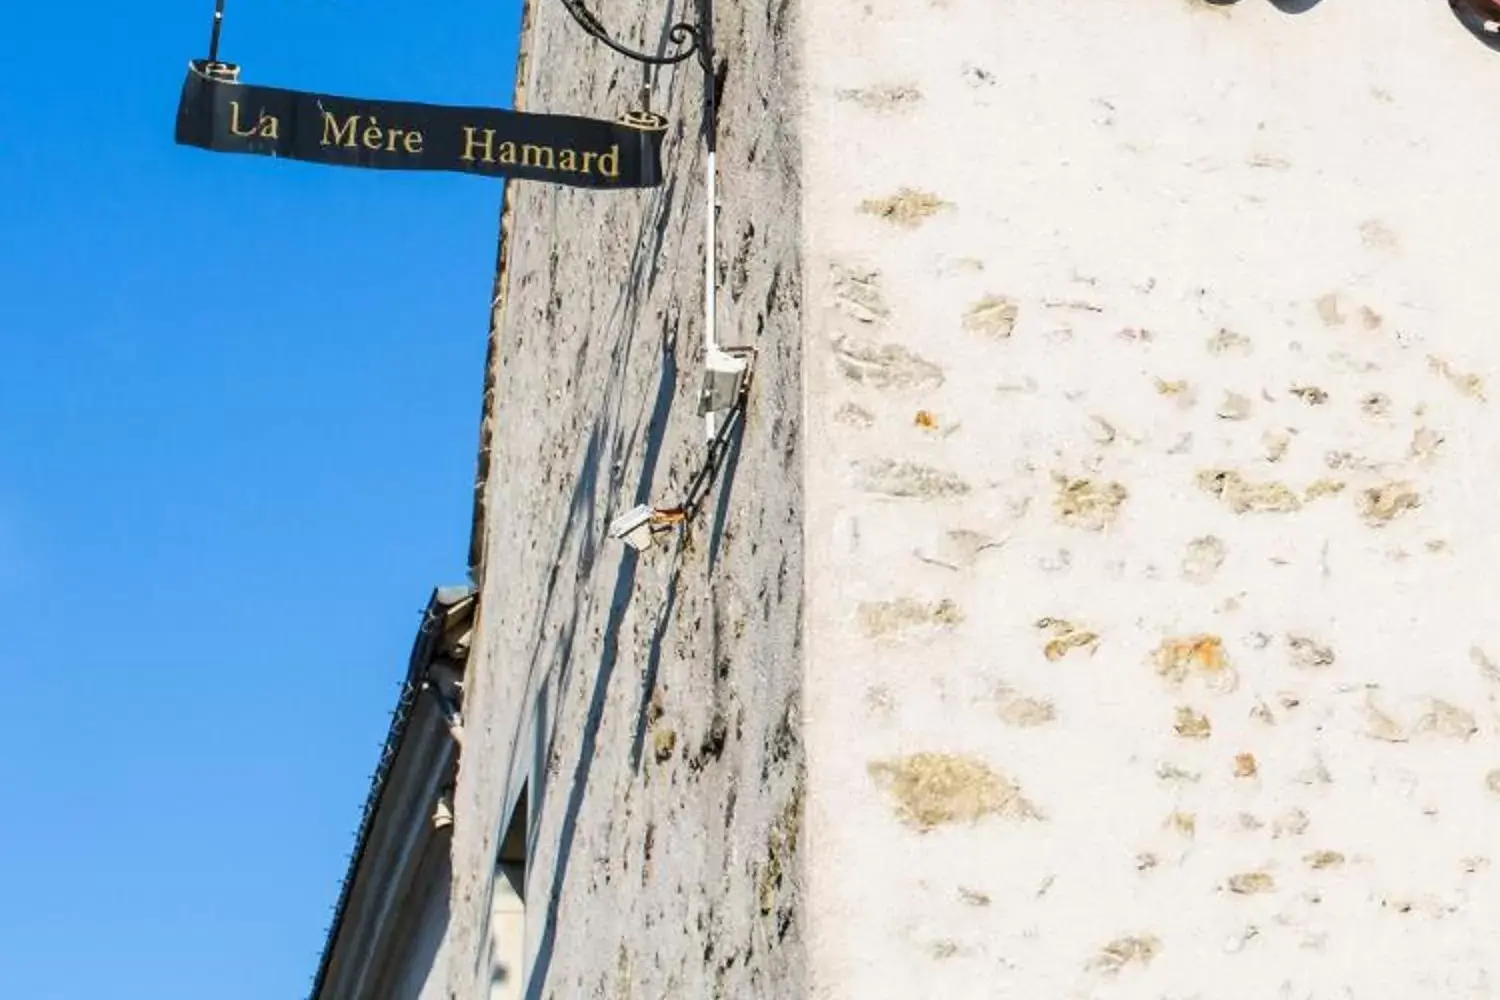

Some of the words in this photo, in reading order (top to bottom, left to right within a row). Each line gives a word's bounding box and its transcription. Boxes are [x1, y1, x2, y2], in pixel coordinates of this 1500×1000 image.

[228, 101, 280, 139] La
[319, 110, 424, 154] Mère
[462, 126, 621, 178] Hamard
